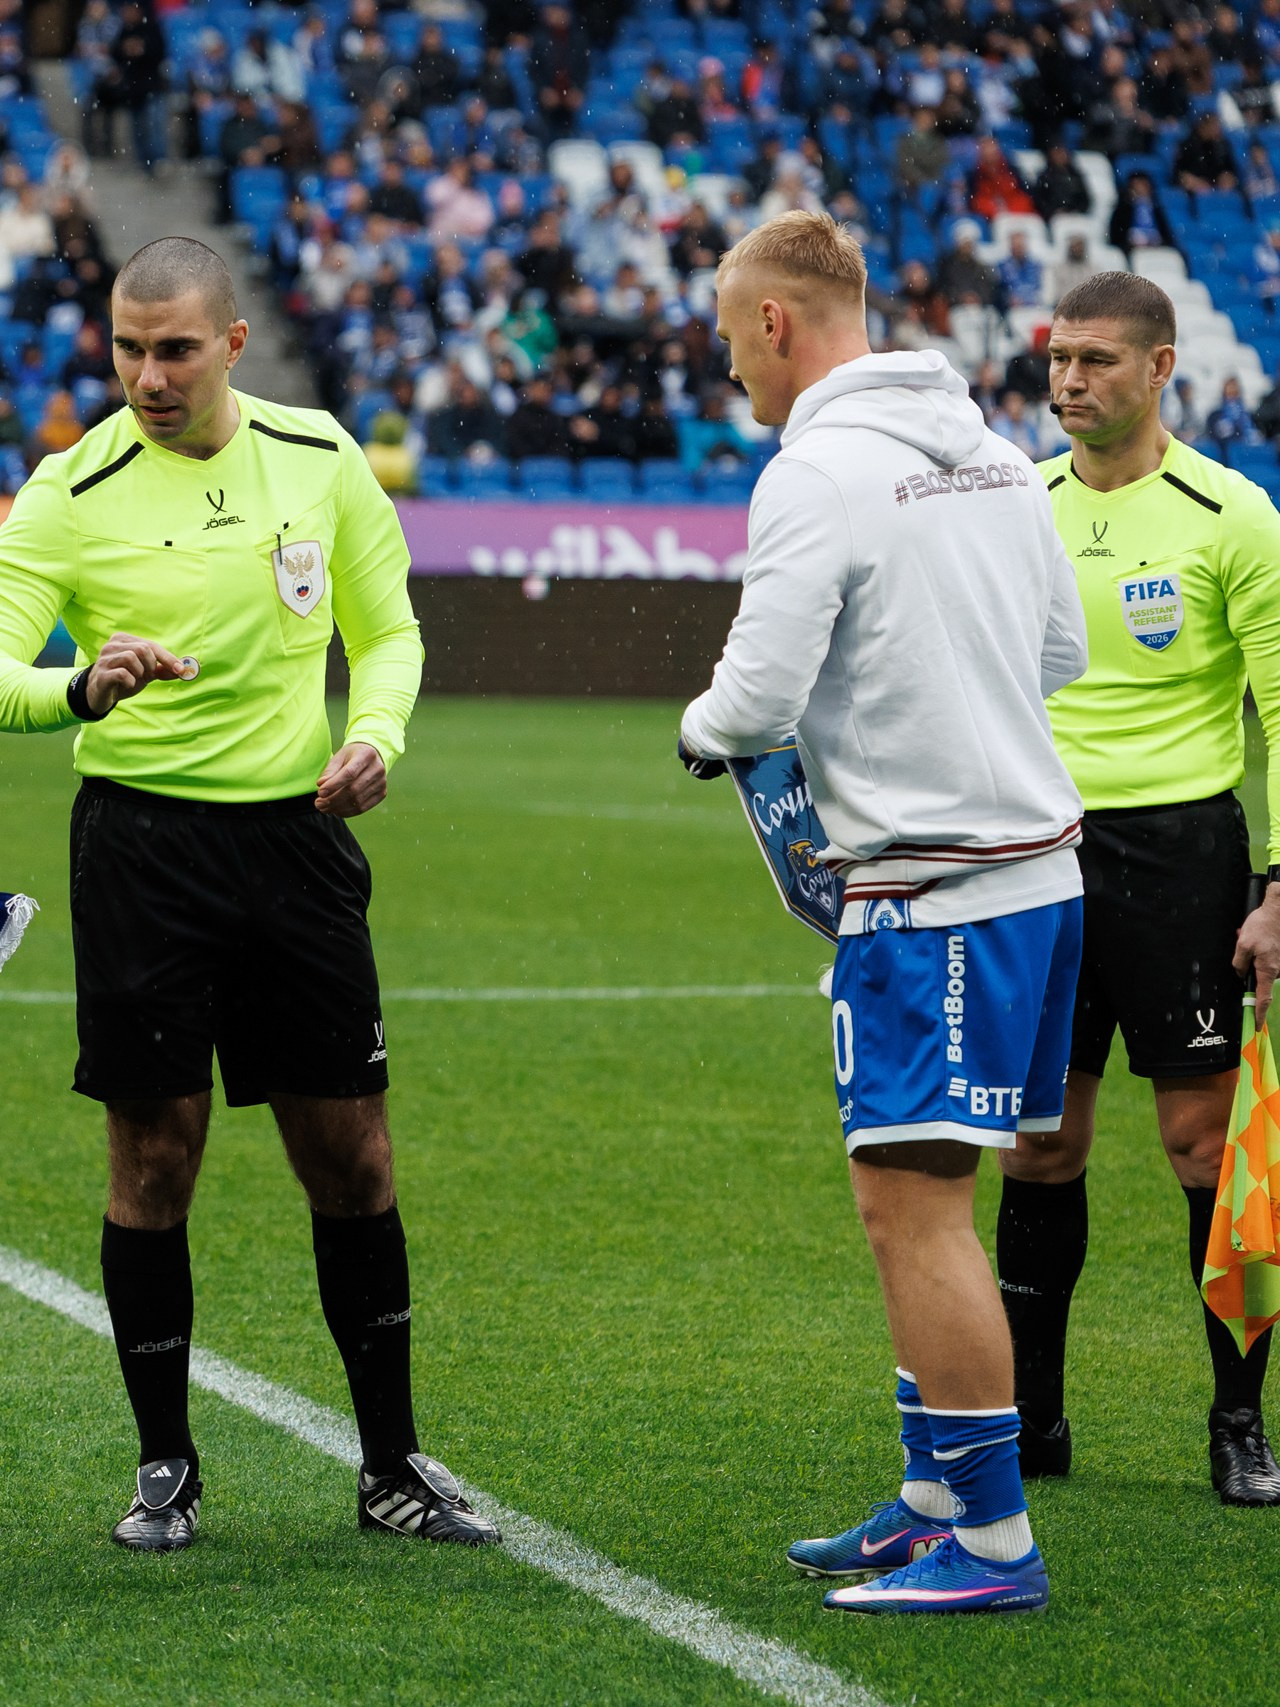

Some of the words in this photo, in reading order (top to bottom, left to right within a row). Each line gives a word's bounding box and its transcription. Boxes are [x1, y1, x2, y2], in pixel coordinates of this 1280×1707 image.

[202, 515, 246, 531] JÖGEL
[1076, 547, 1116, 558] JÖGEL
[1125, 579, 1176, 602] FIFA
[1129, 604, 1178, 618] ASSISTANT
[1133, 613, 1175, 627] REFEREE
[1145, 633, 1169, 645] 2026
[944, 935, 966, 1063] BetBoom
[1187, 1036, 1229, 1048] JÖGEL
[128, 1335, 188, 1353] JÖGEL
